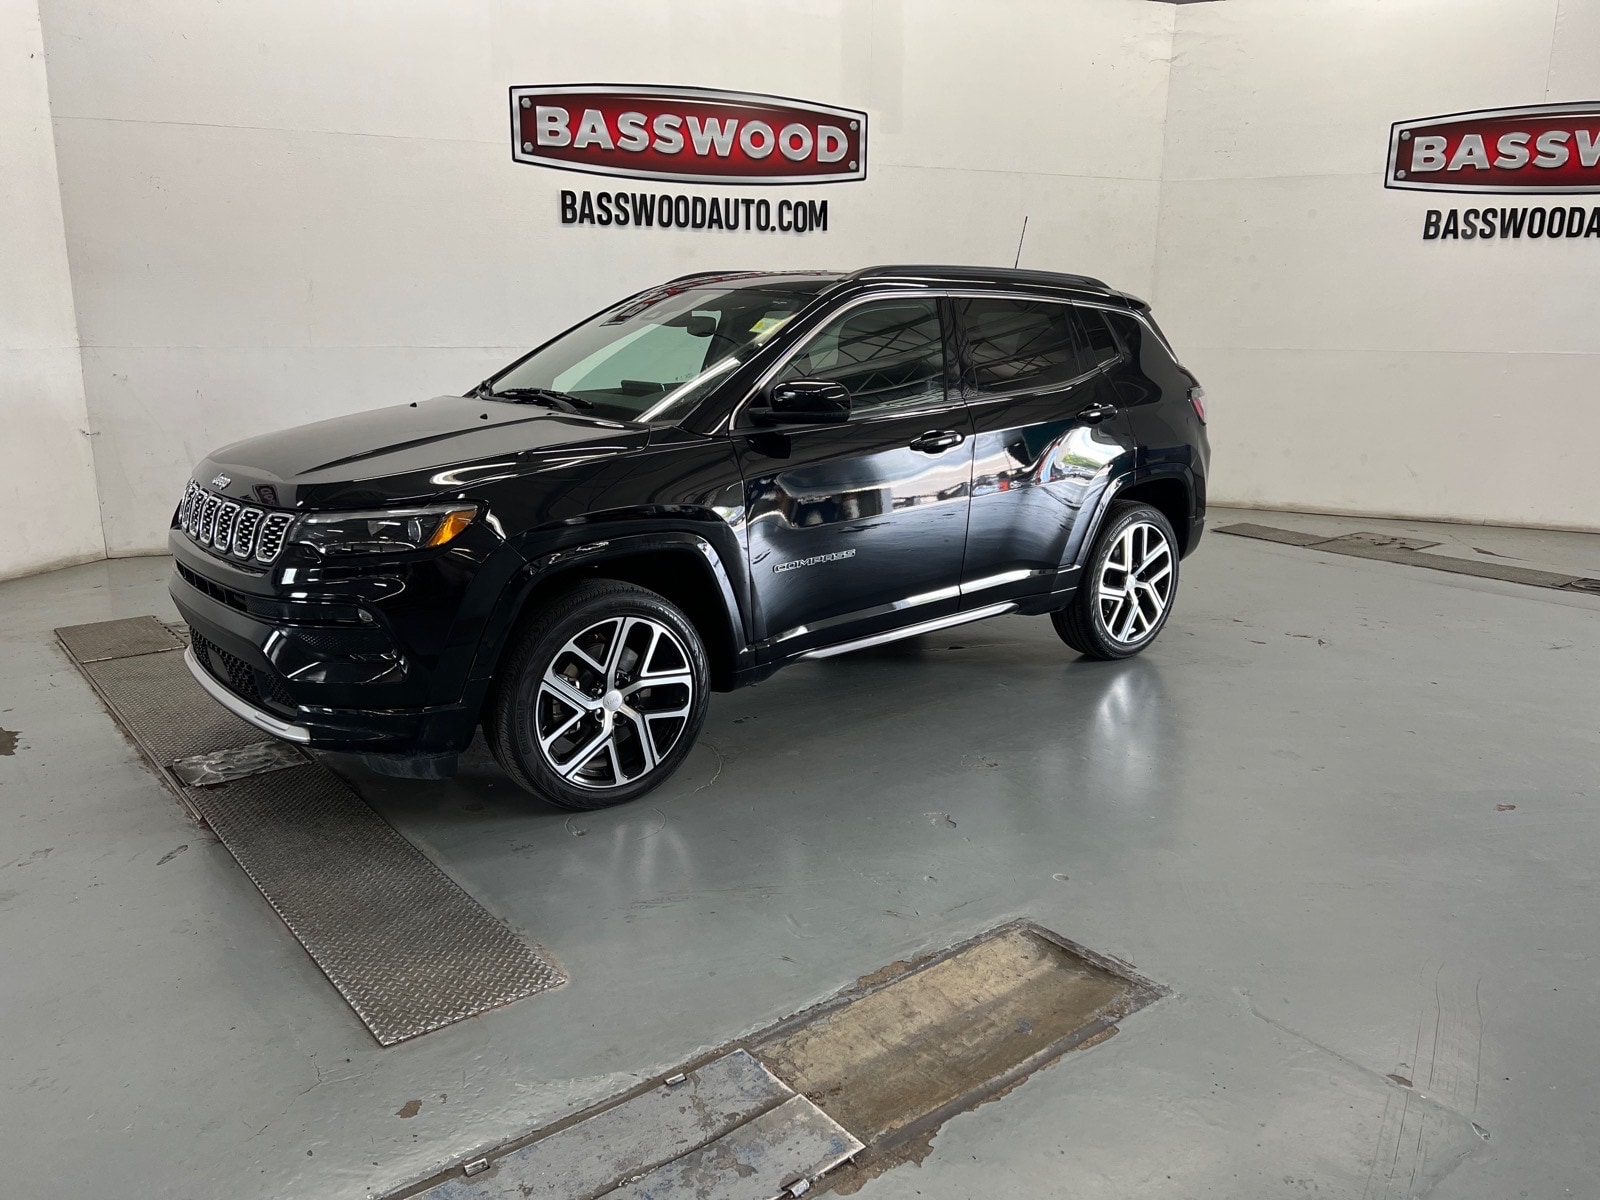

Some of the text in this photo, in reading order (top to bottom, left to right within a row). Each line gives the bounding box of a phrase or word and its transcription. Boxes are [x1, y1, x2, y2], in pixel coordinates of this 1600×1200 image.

[536, 105, 849, 163] BASSWOOD
[560, 189, 829, 233] BASSWOODAUTO.COM
[1422, 206, 1600, 240] BASSWOODA
[212, 472, 231, 490] Jeep
[773, 549, 856, 573] COMPASS
